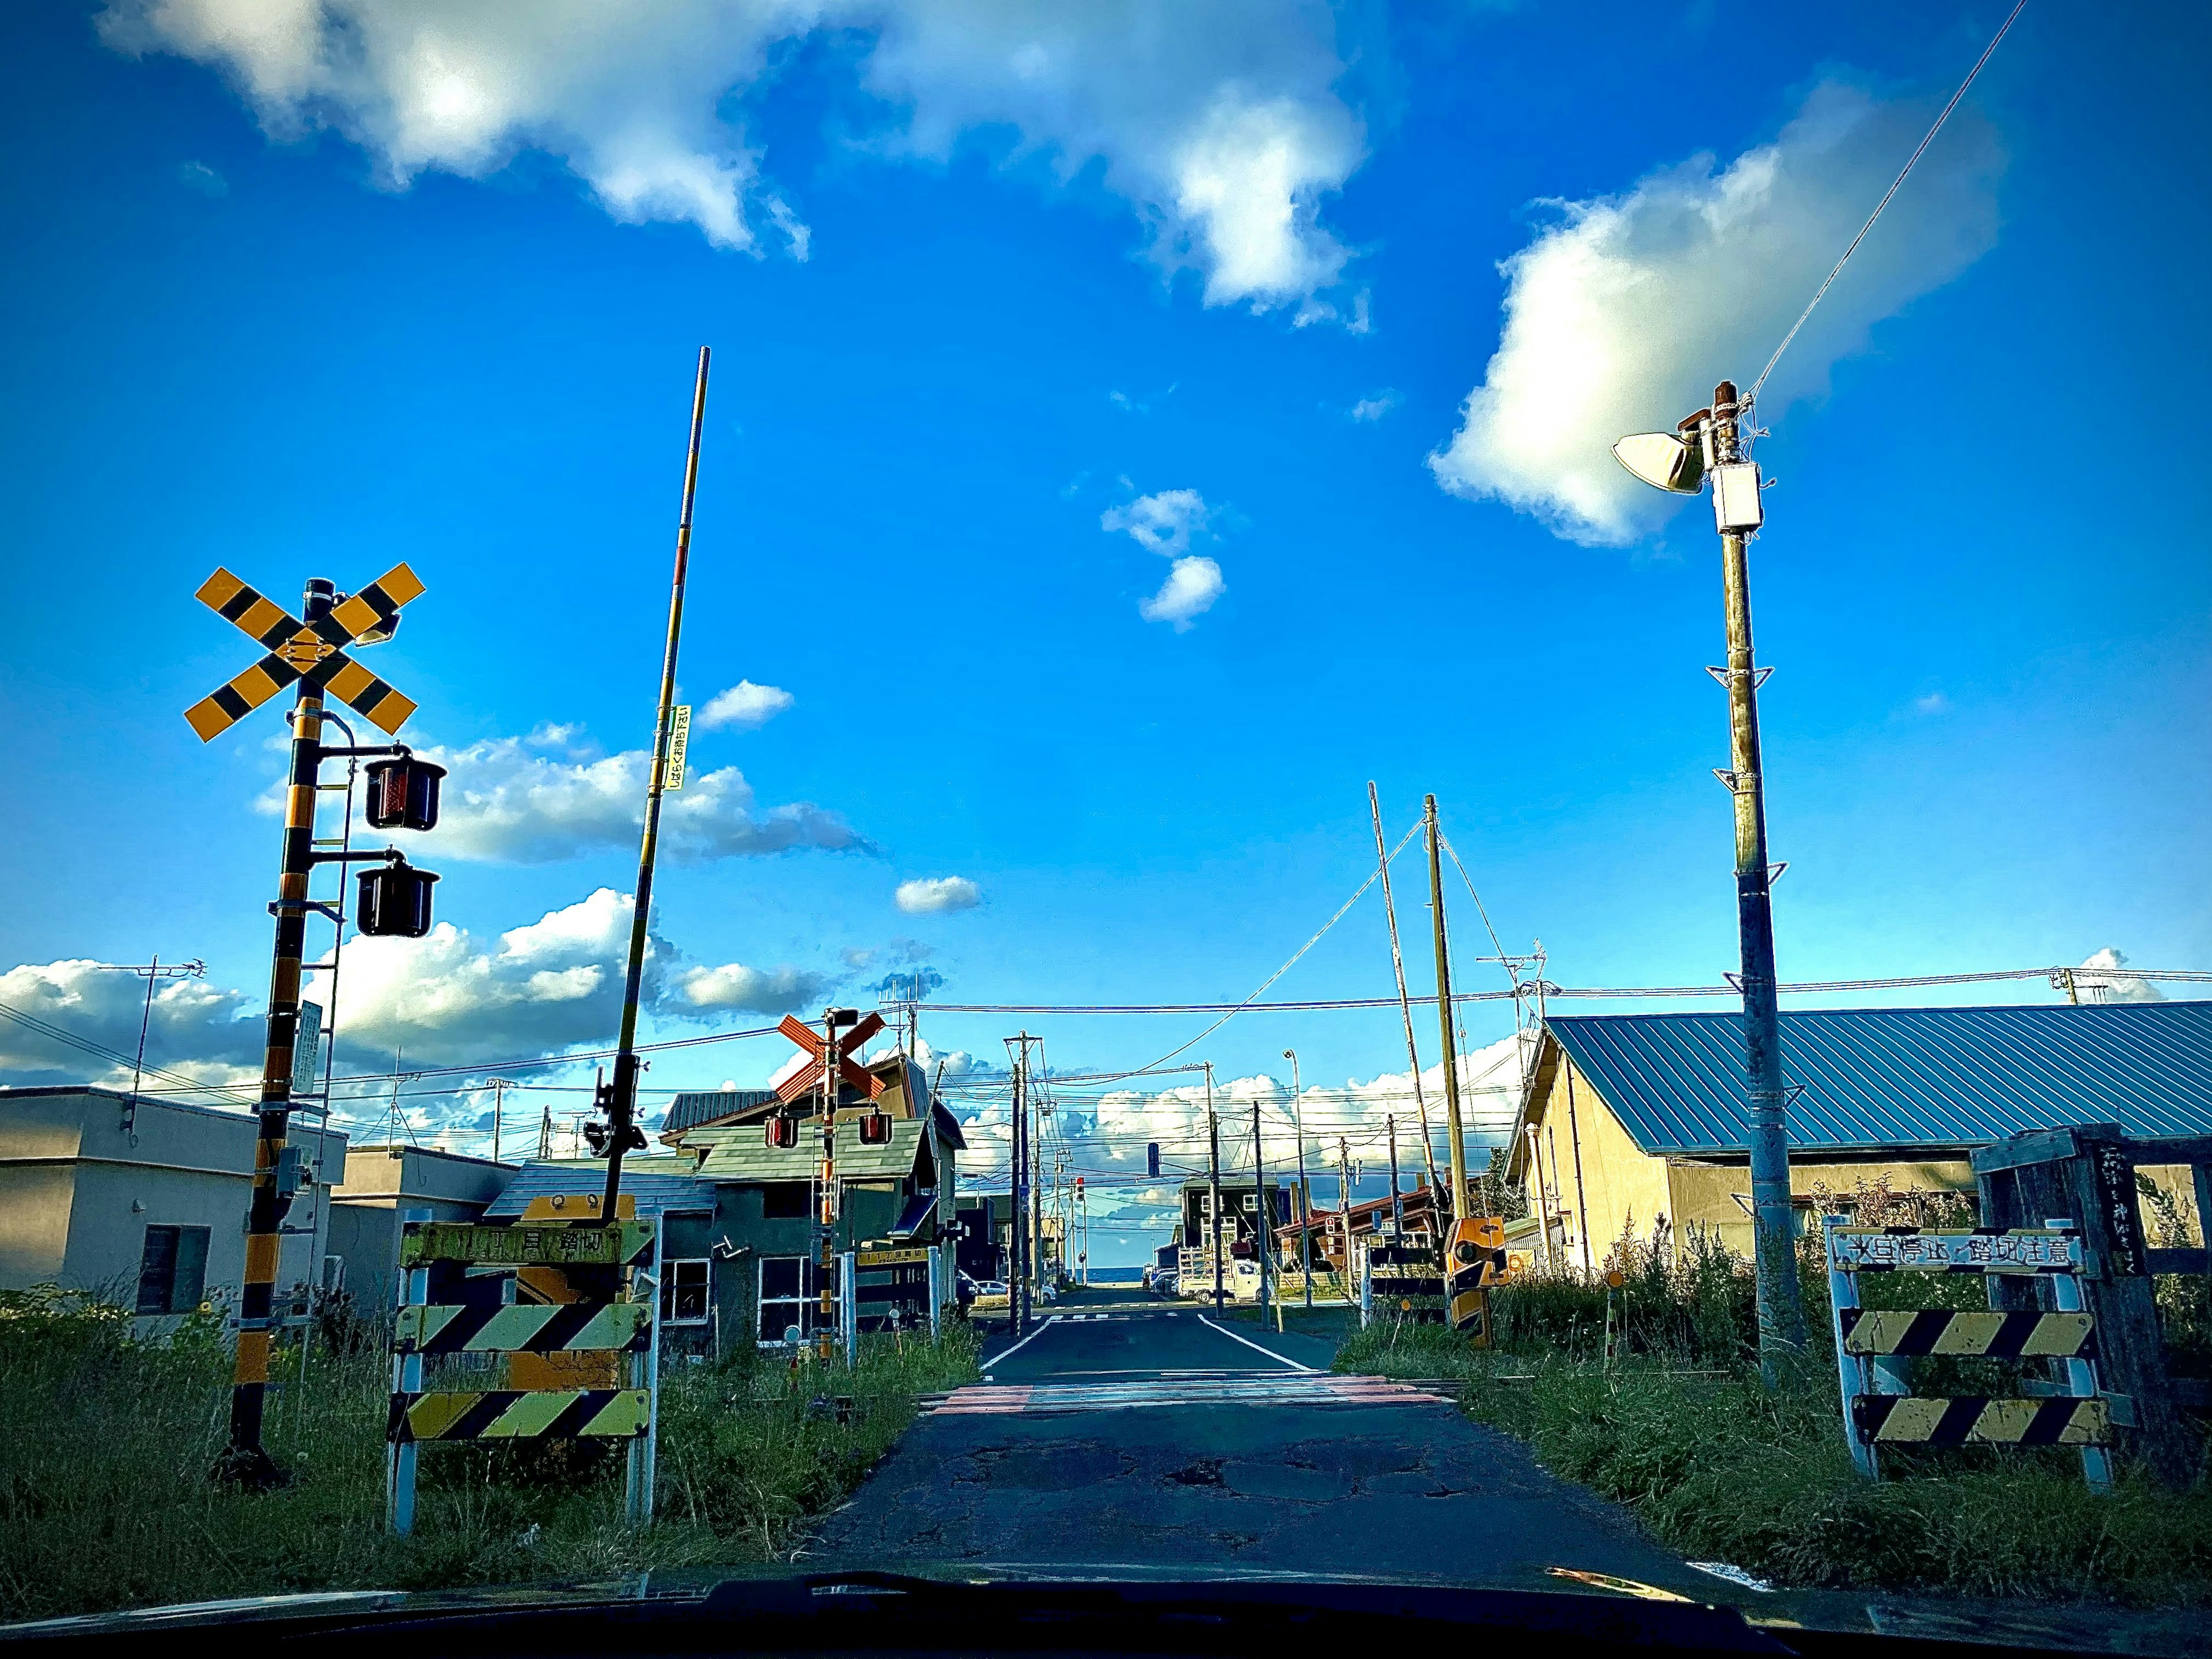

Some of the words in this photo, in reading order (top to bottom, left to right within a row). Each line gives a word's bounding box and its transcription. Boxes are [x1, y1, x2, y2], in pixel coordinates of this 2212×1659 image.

[670, 707, 688, 788] しばらくお待ち下さい
